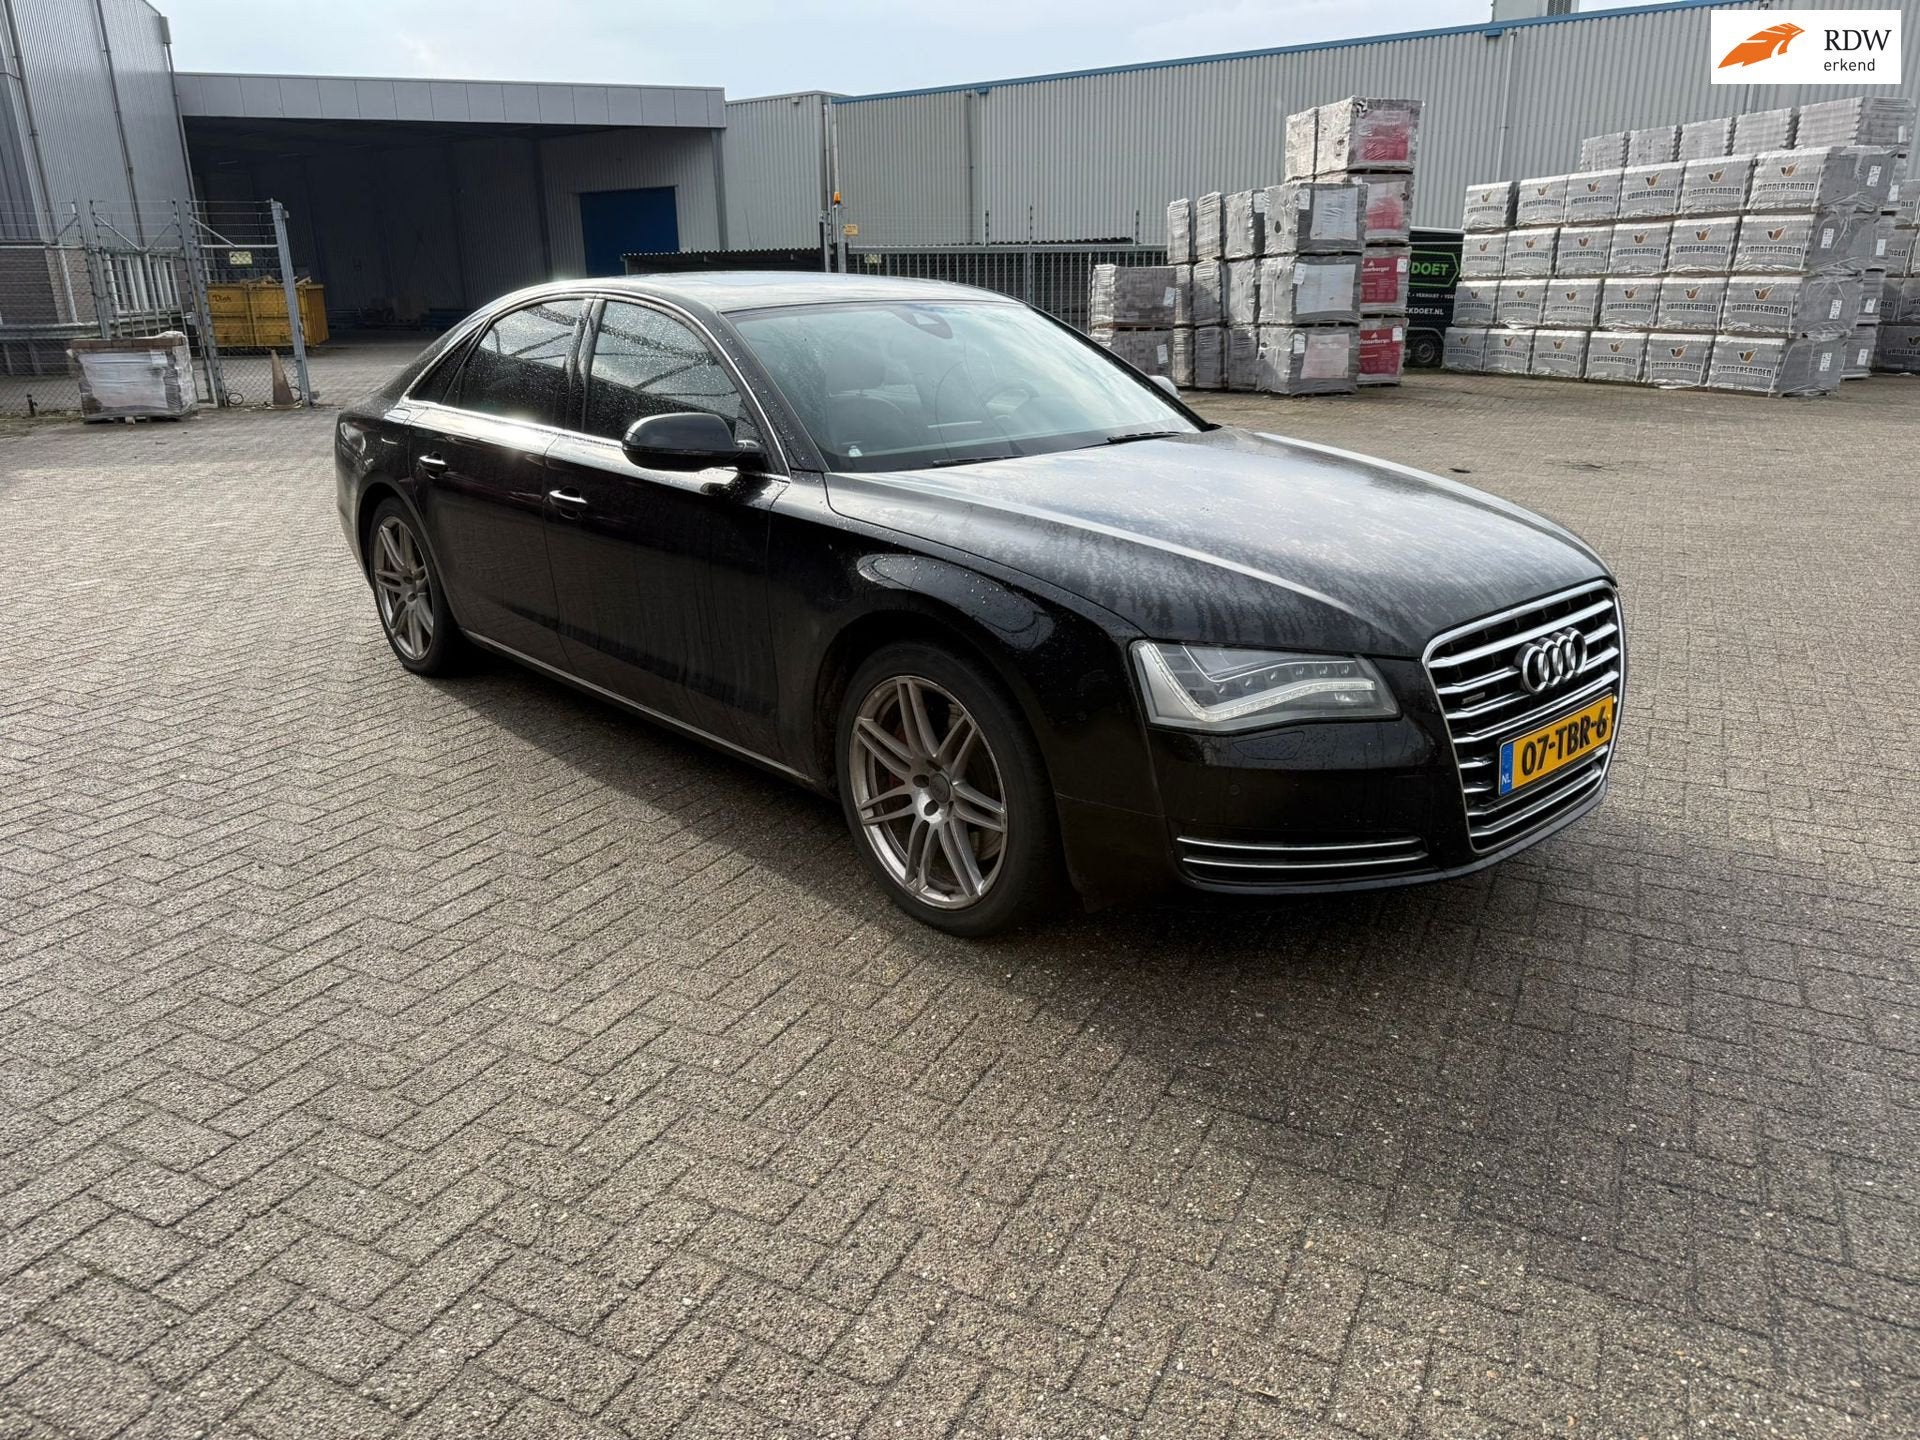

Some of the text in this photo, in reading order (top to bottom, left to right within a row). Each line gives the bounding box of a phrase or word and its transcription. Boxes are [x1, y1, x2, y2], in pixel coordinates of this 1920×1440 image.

[1411, 262, 1449, 276] DOET
[1521, 706, 1608, 776] 07-TBR-6
[1501, 773, 1511, 785] NL
